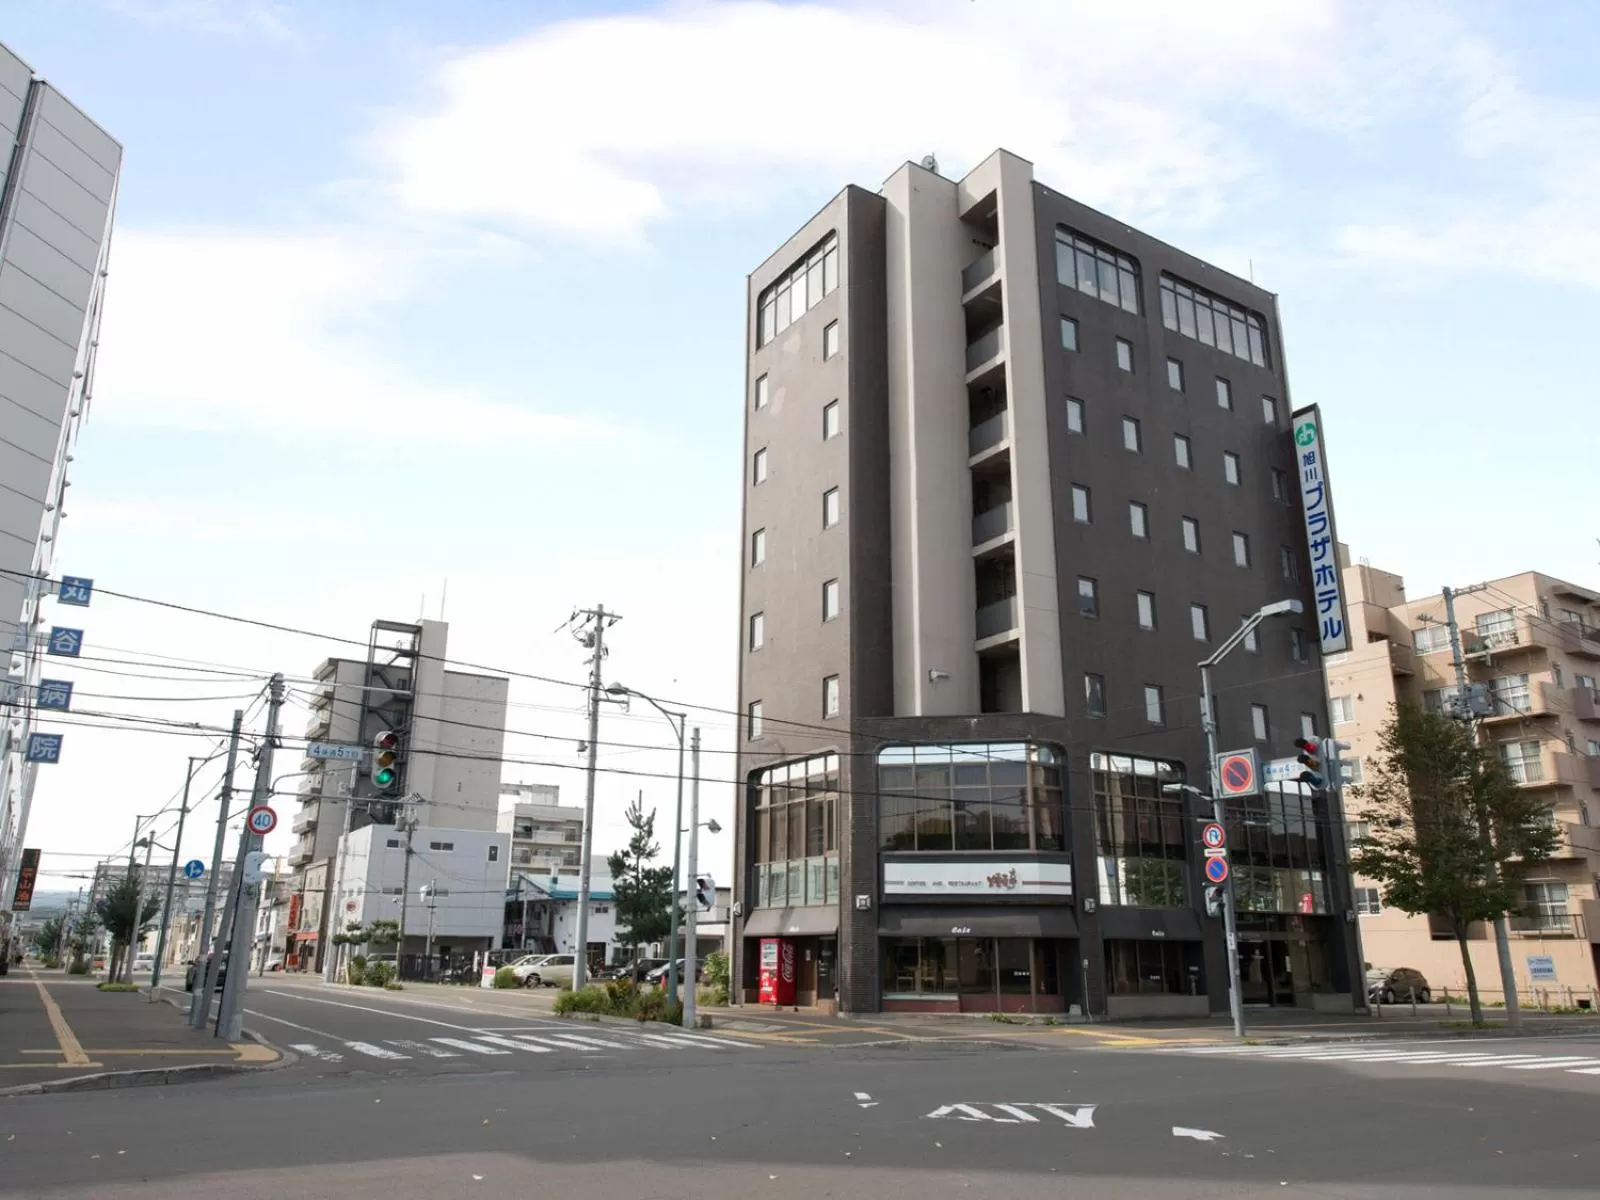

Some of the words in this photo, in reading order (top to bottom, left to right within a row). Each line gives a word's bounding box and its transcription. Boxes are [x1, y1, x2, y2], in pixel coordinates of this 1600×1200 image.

[1302, 450, 1343, 641] 旭川プラザホテル
[253, 813, 272, 828] 40
